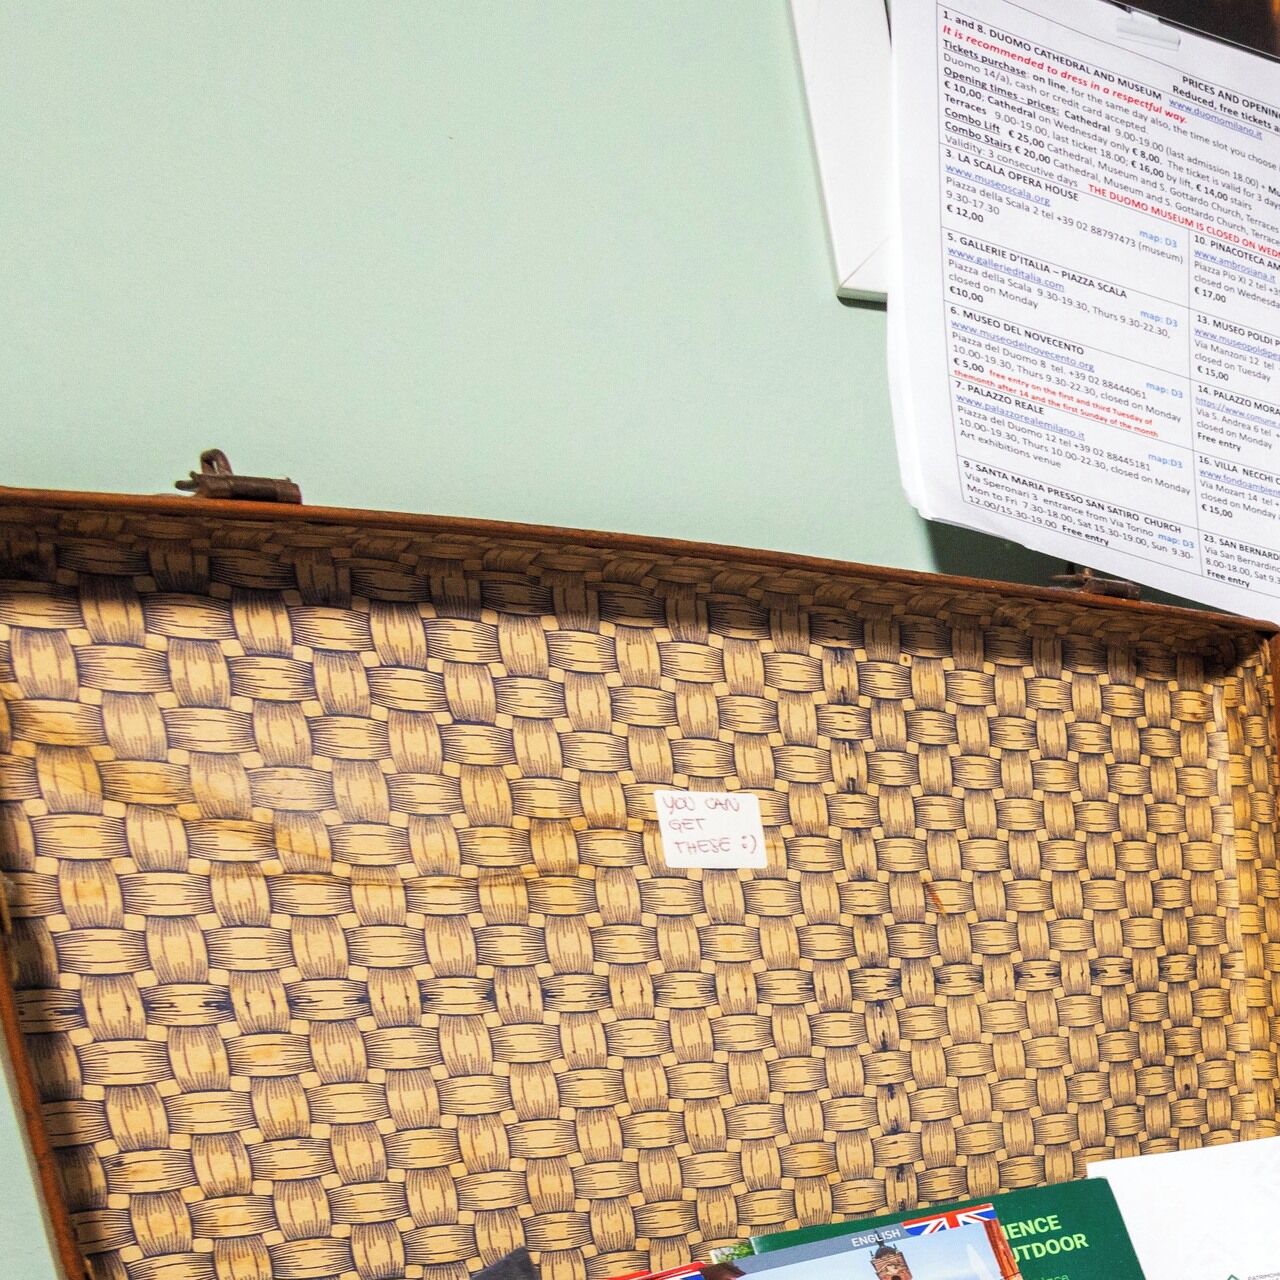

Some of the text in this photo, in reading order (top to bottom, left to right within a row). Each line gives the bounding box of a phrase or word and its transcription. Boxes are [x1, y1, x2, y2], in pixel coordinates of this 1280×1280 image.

[944, 11, 1162, 100] 1. and 8. DUOMO CATHEDRAL AND MUSEUM
[958, 153, 971, 166] LA
[974, 159, 1005, 176] SCALA
[1008, 170, 1042, 189] OPERA
[1046, 184, 1079, 201] HOUSE
[1196, 314, 1210, 326] 13.
[1212, 320, 1246, 337] MUSEO
[1248, 330, 1273, 346] POLDI
[662, 796, 740, 815] YOU CAN
[668, 818, 705, 833] GET
[674, 837, 730, 854] THESE
[852, 1229, 901, 1247] ENGLISH
